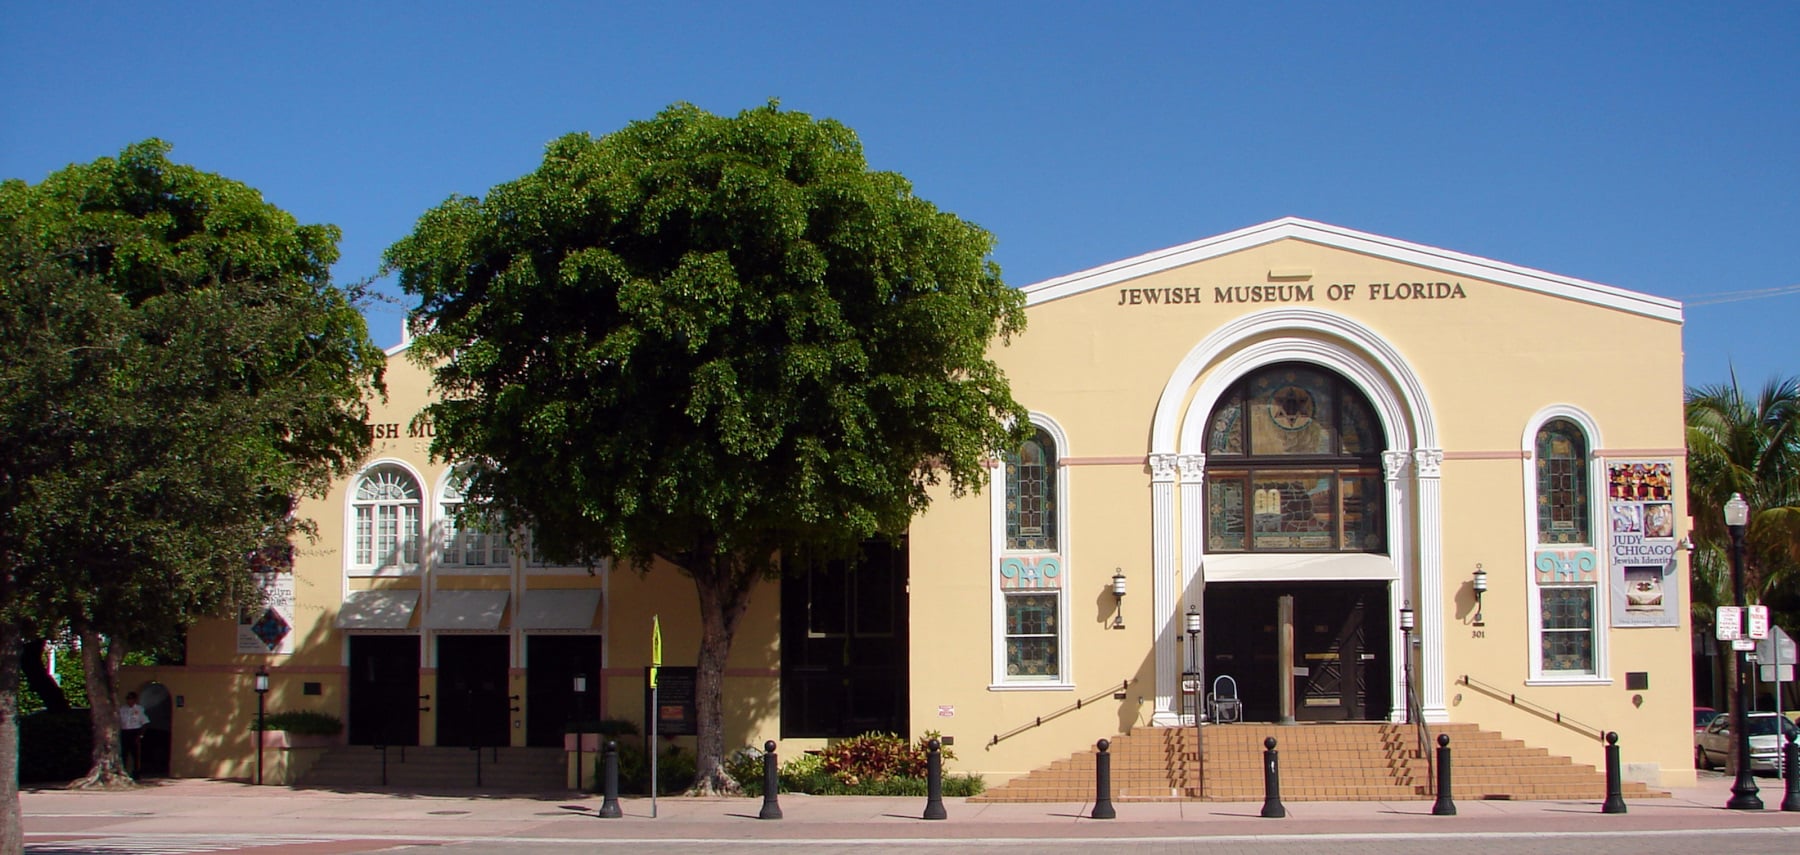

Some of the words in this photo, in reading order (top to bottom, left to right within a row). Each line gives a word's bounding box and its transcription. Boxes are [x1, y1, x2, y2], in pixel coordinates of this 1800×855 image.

[1118, 287, 1201, 305] JEWISH
[1214, 284, 1314, 304] MUSEUM
[1327, 283, 1356, 301] OF
[1369, 282, 1467, 300] FLORIDA
[365, 423, 400, 438] ISH
[1612, 535, 1643, 547] JUDY
[1615, 545, 1674, 556] CHICAGO
[1612, 556, 1640, 566] Jewish
[1471, 630, 1485, 639] 301
